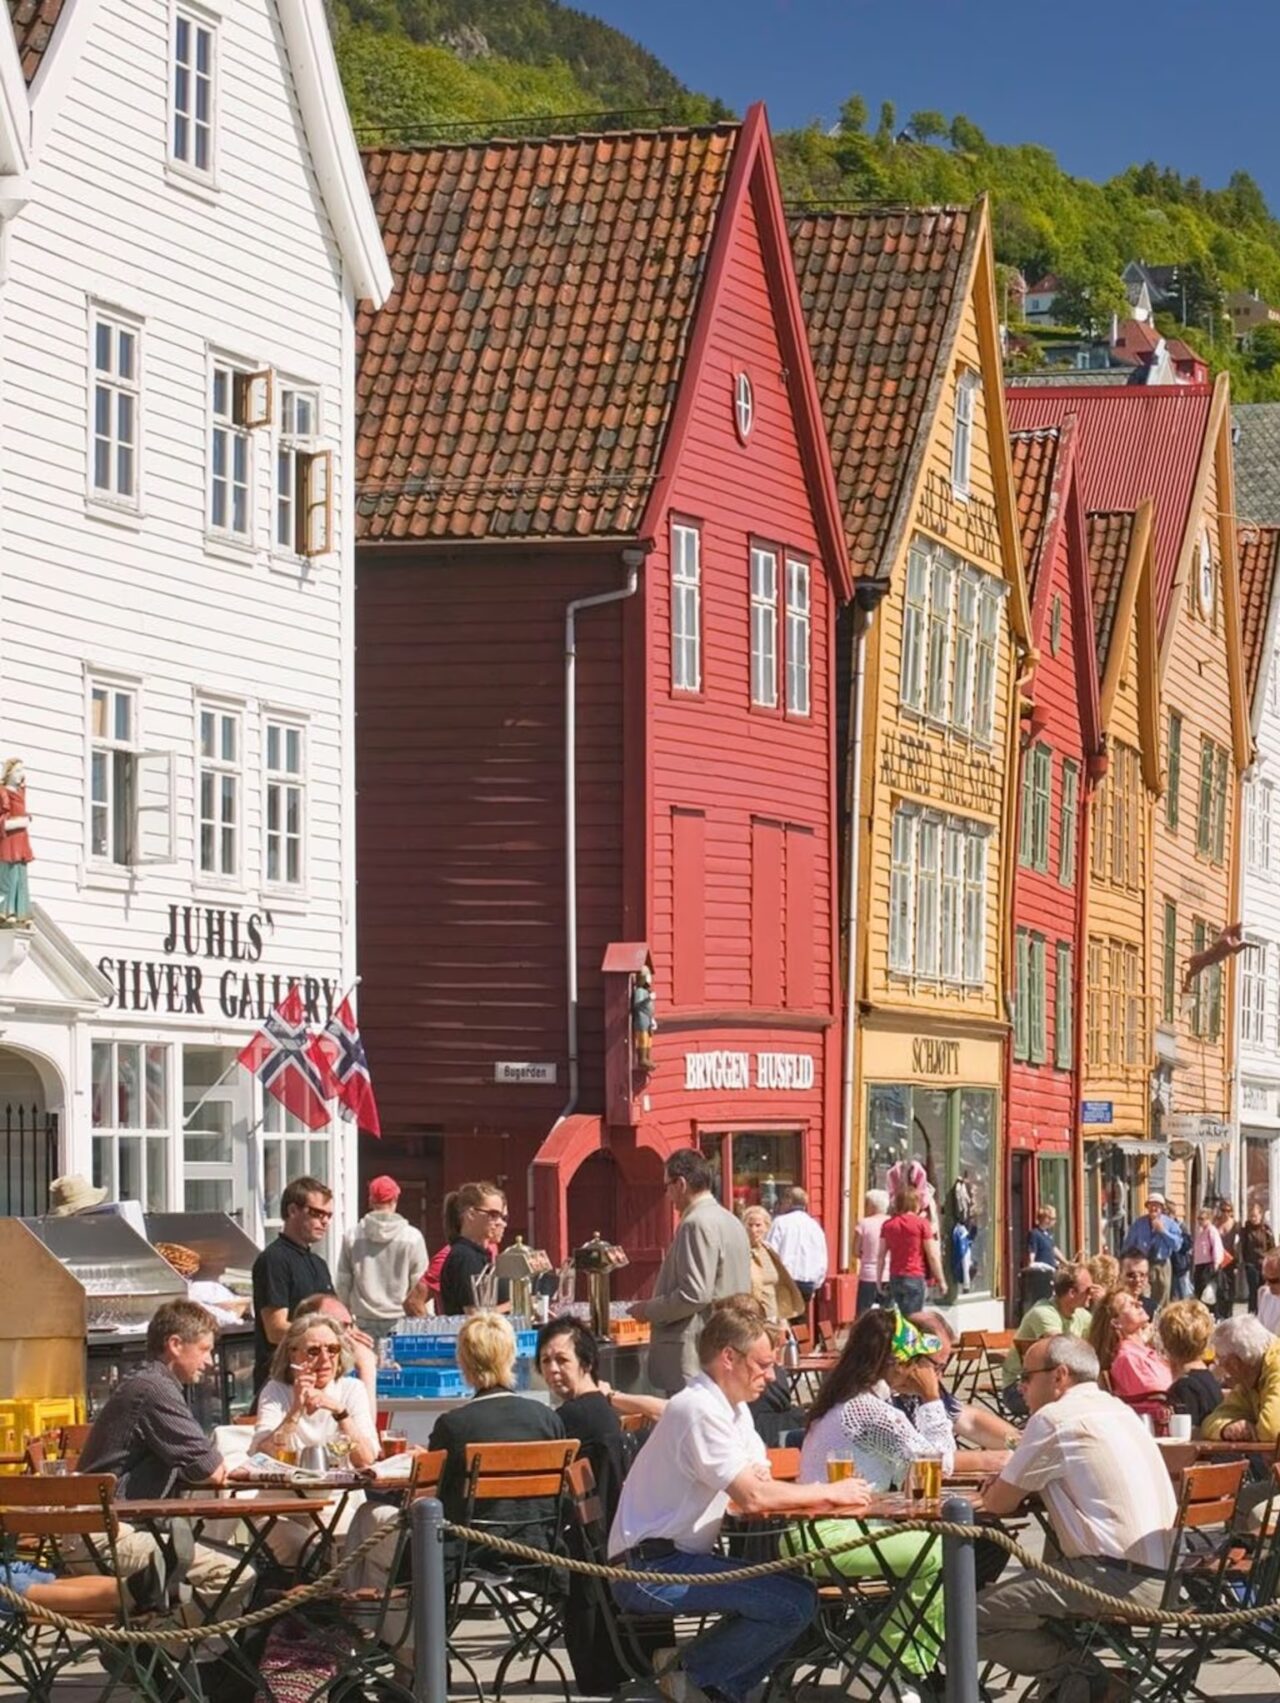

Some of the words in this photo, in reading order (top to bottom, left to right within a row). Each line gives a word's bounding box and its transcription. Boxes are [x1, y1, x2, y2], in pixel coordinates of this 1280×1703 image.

[164, 904, 274, 963] JUHLS'
[98, 957, 204, 1014] SILVER
[684, 1050, 749, 1090] BRYGGEN
[755, 1053, 814, 1090] HUSFLID
